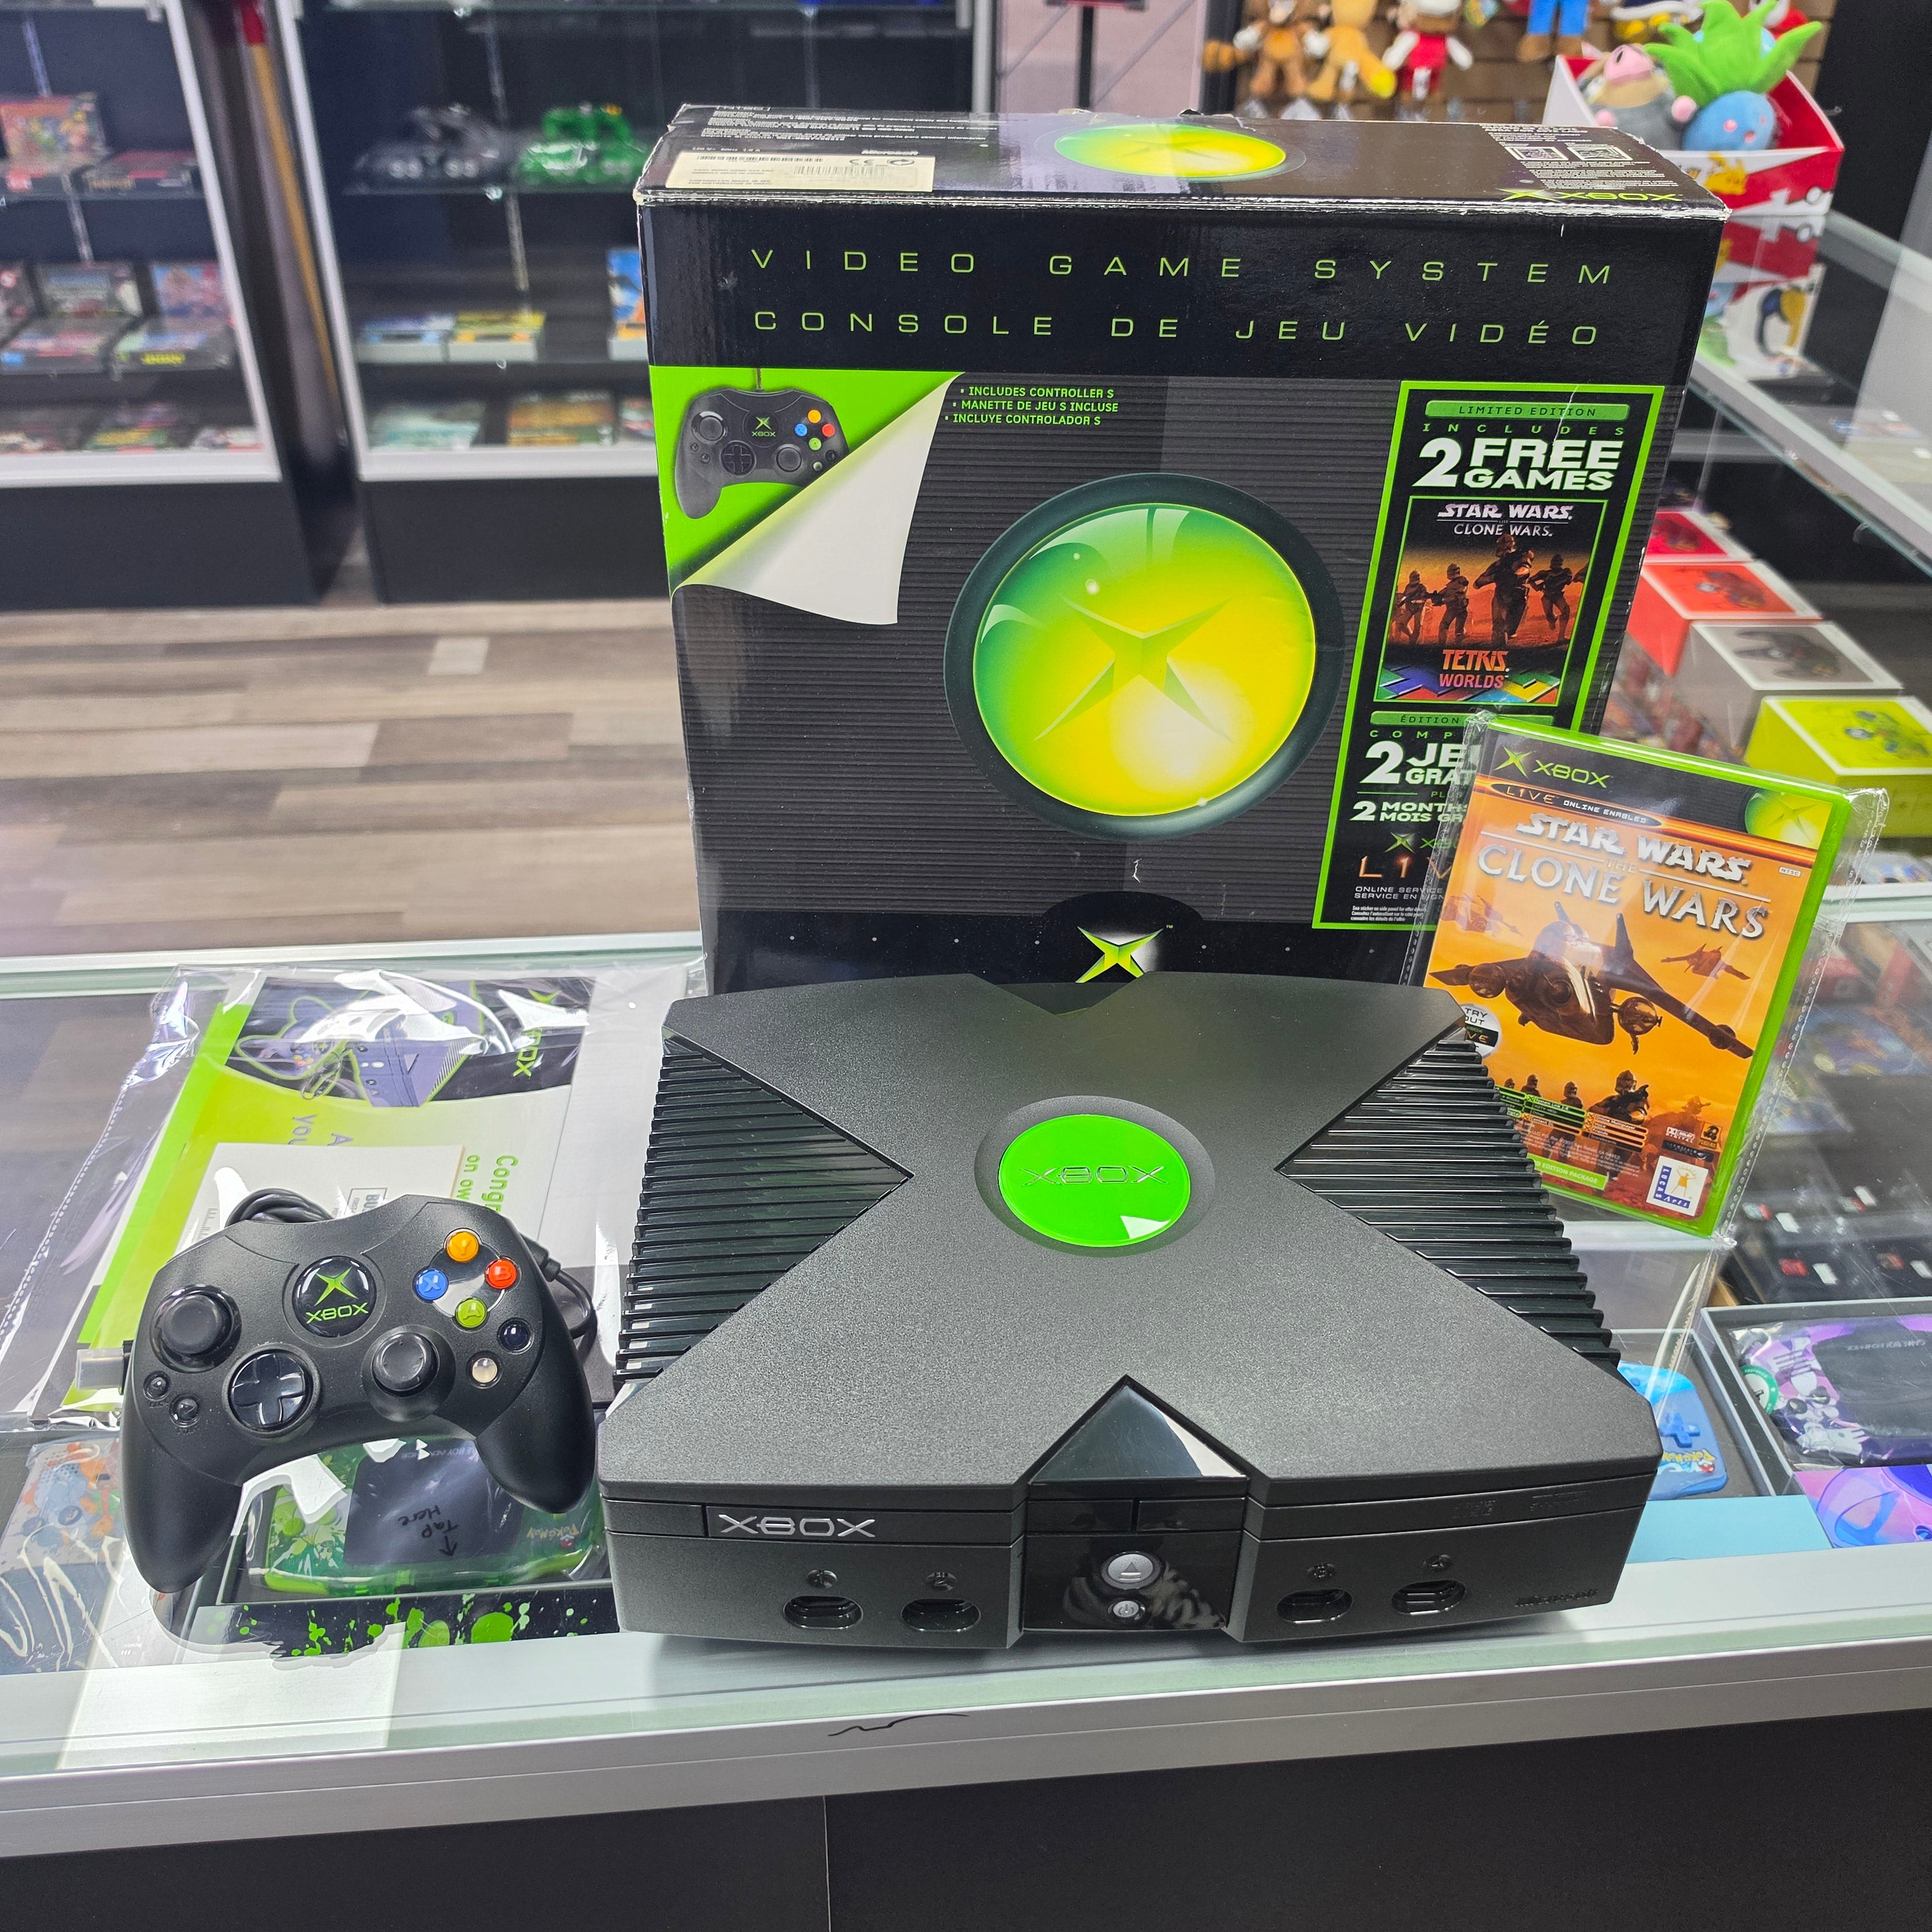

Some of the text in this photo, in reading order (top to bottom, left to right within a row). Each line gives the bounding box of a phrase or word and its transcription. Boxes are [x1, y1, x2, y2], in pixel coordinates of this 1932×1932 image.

[1555, 192, 1683, 201] XBOX
[752, 249, 1610, 284] VIDEO GAME SYSTEM
[755, 311, 1596, 345] CONSOLE DE JEU VIDÉO
[969, 387, 1114, 398] INCLUDES CONTROLLER S
[961, 400, 1118, 412] MANETTE DE JEU S INCLUSE
[1459, 406, 1596, 416] LIMITED EDITION
[953, 414, 1100, 426] INCLUYE CONTROLADOR S
[1423, 423, 1624, 435] INCLUDES
[1412, 437, 1623, 487] 2 FREE
[1463, 468, 1614, 491] GAMES
[1437, 504, 1502, 519] STAR
[1454, 524, 1503, 535] CLONE
[1442, 650, 1506, 671] TETRIS
[1439, 673, 1504, 688] WORLDS
[1401, 714, 1459, 724] ÉDITION
[1359, 741, 1404, 784] 2
[1533, 760, 1610, 788] XBOX
[1350, 801, 1376, 821] 2
[1505, 786, 1646, 823] LIVE ONLINE ENABLED
[1379, 812, 1431, 822] MOIS
[1516, 812, 1625, 856] STAR
[1608, 858, 1637, 873] THE
[1478, 844, 1769, 938] CLONE WARS
[1465, 1008, 1488, 1018] TRY
[459, 1154, 480, 1173] on
[1542, 1163, 1569, 1175] EDITION
[1569, 1171, 1598, 1184] PACKAGE
[1020, 1166, 1169, 1186] XBOX
[1655, 1169, 1669, 1198] LUCAS
[453, 1239, 472, 1255] Y
[495, 1266, 511, 1281] B
[424, 1276, 440, 1293] X
[305, 1302, 369, 1324] XBOX
[462, 1300, 482, 1320] A
[398, 1505, 441, 1526] Here
[719, 1514, 876, 1538] XBOX
